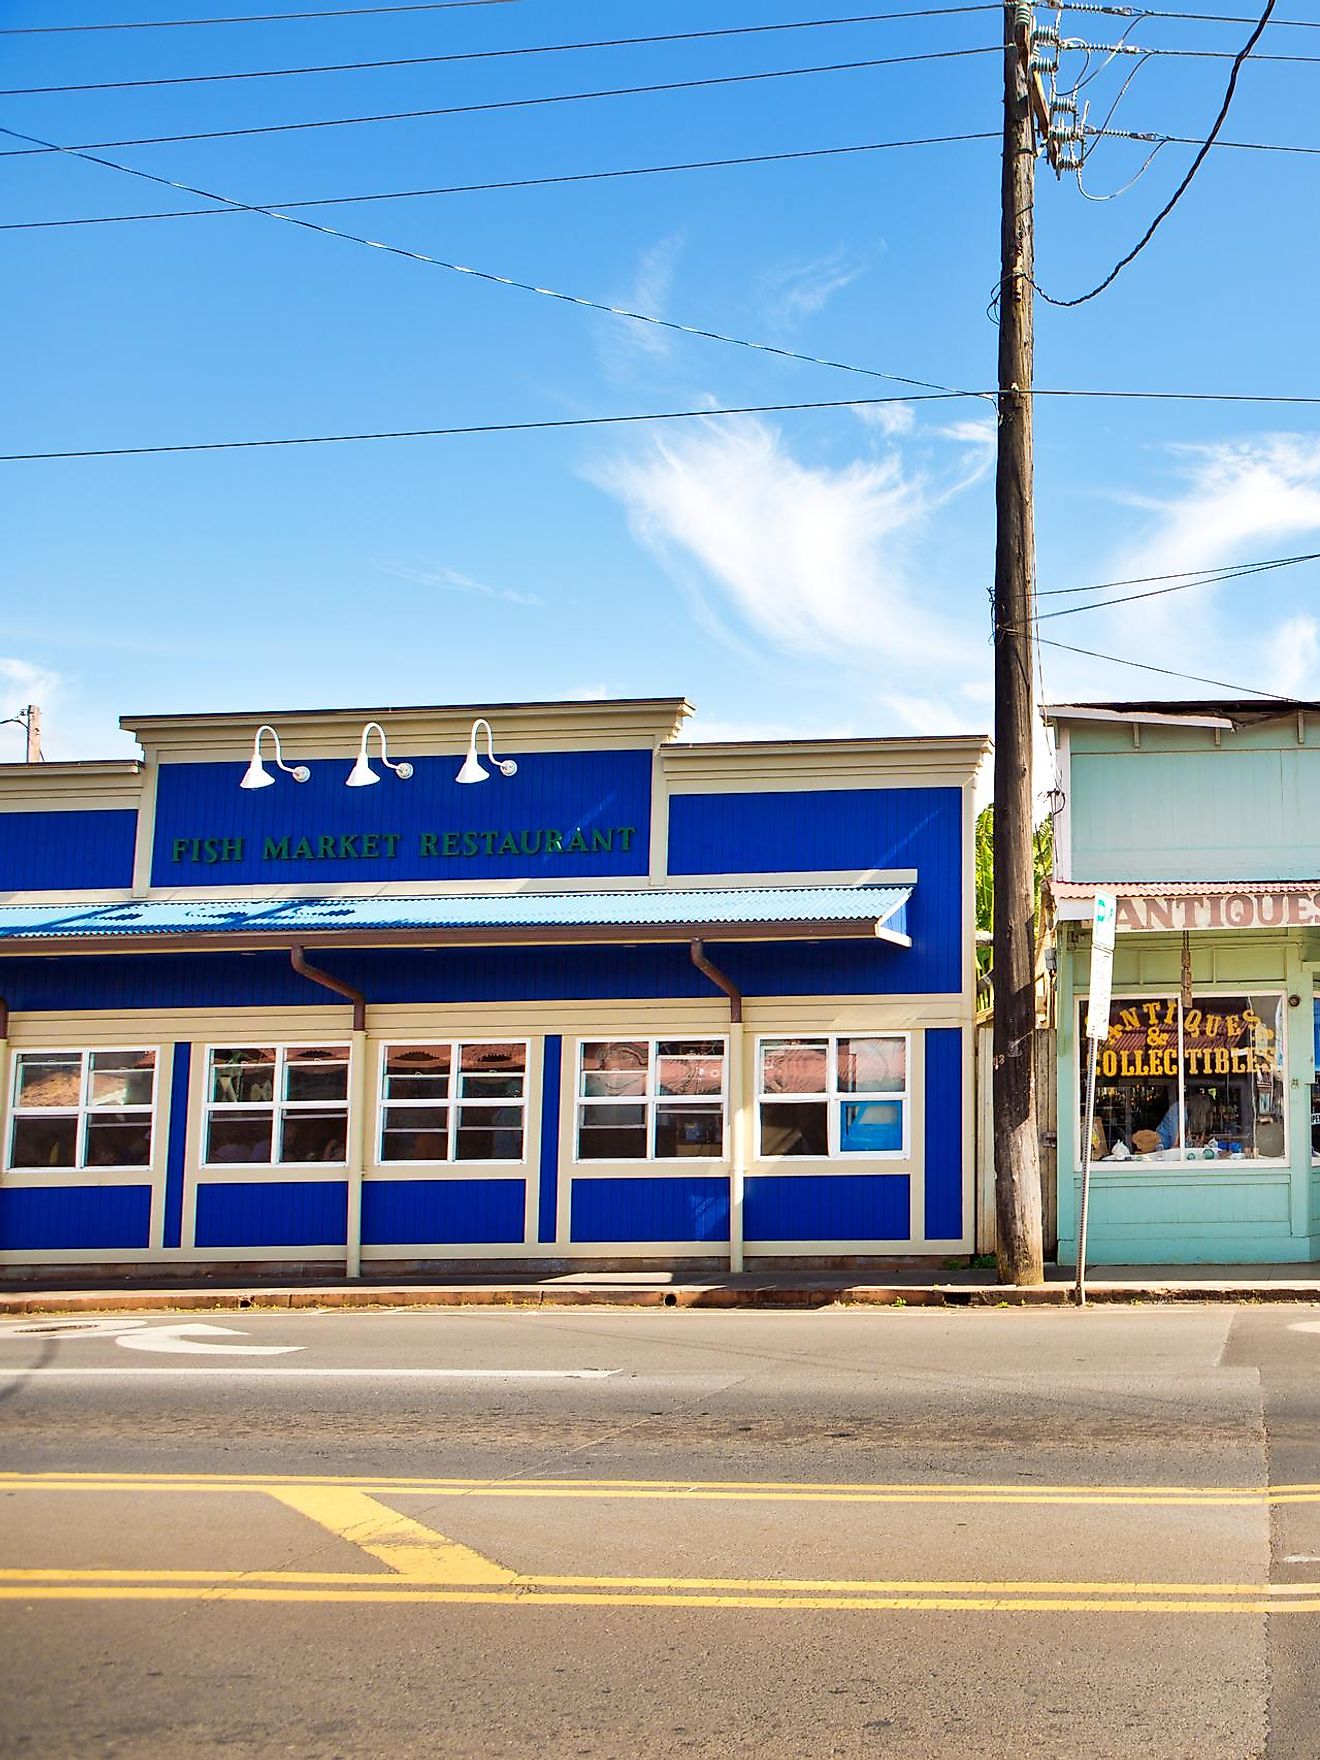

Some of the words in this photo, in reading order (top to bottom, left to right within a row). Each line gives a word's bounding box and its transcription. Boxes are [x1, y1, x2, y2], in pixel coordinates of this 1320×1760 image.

[171, 837, 244, 863] FISH
[263, 833, 400, 860] MARKET
[420, 826, 636, 858] RESTAURANT
[1147, 1026, 1168, 1046] &
